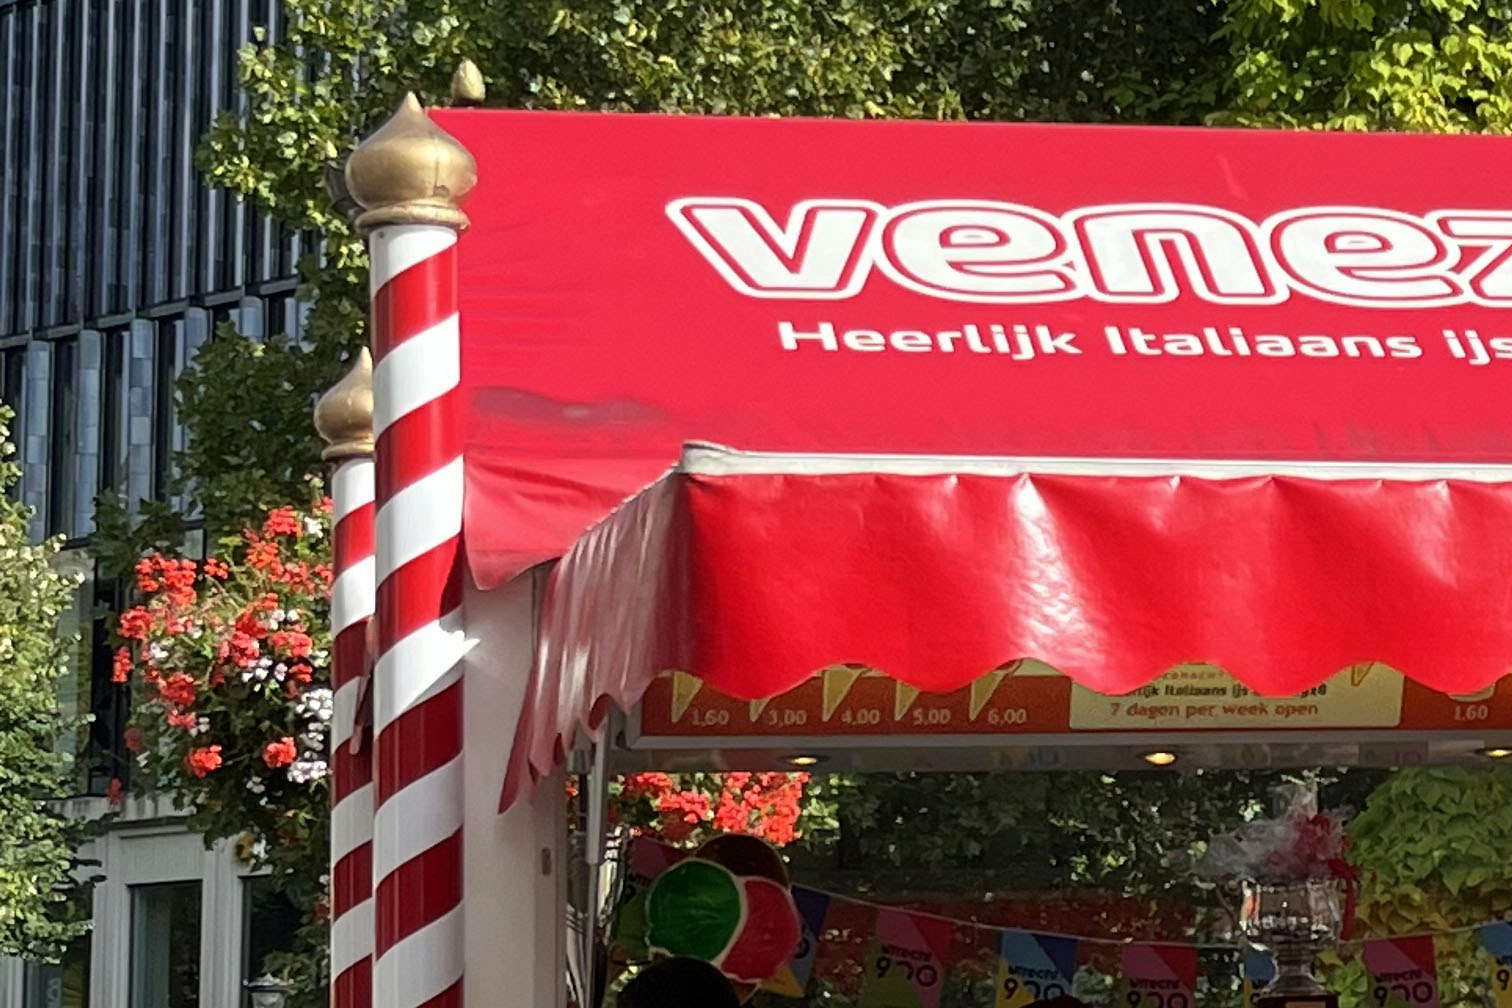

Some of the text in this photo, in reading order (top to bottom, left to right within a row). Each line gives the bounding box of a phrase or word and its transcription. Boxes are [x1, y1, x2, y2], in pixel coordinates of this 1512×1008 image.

[778, 321, 1082, 361] Heerlijk
[1104, 324, 1423, 359] Italiaans
[1127, 701, 1180, 719] dagen
[1186, 704, 1217, 719] per
[1223, 701, 1268, 716] week
[1275, 704, 1318, 719] open
